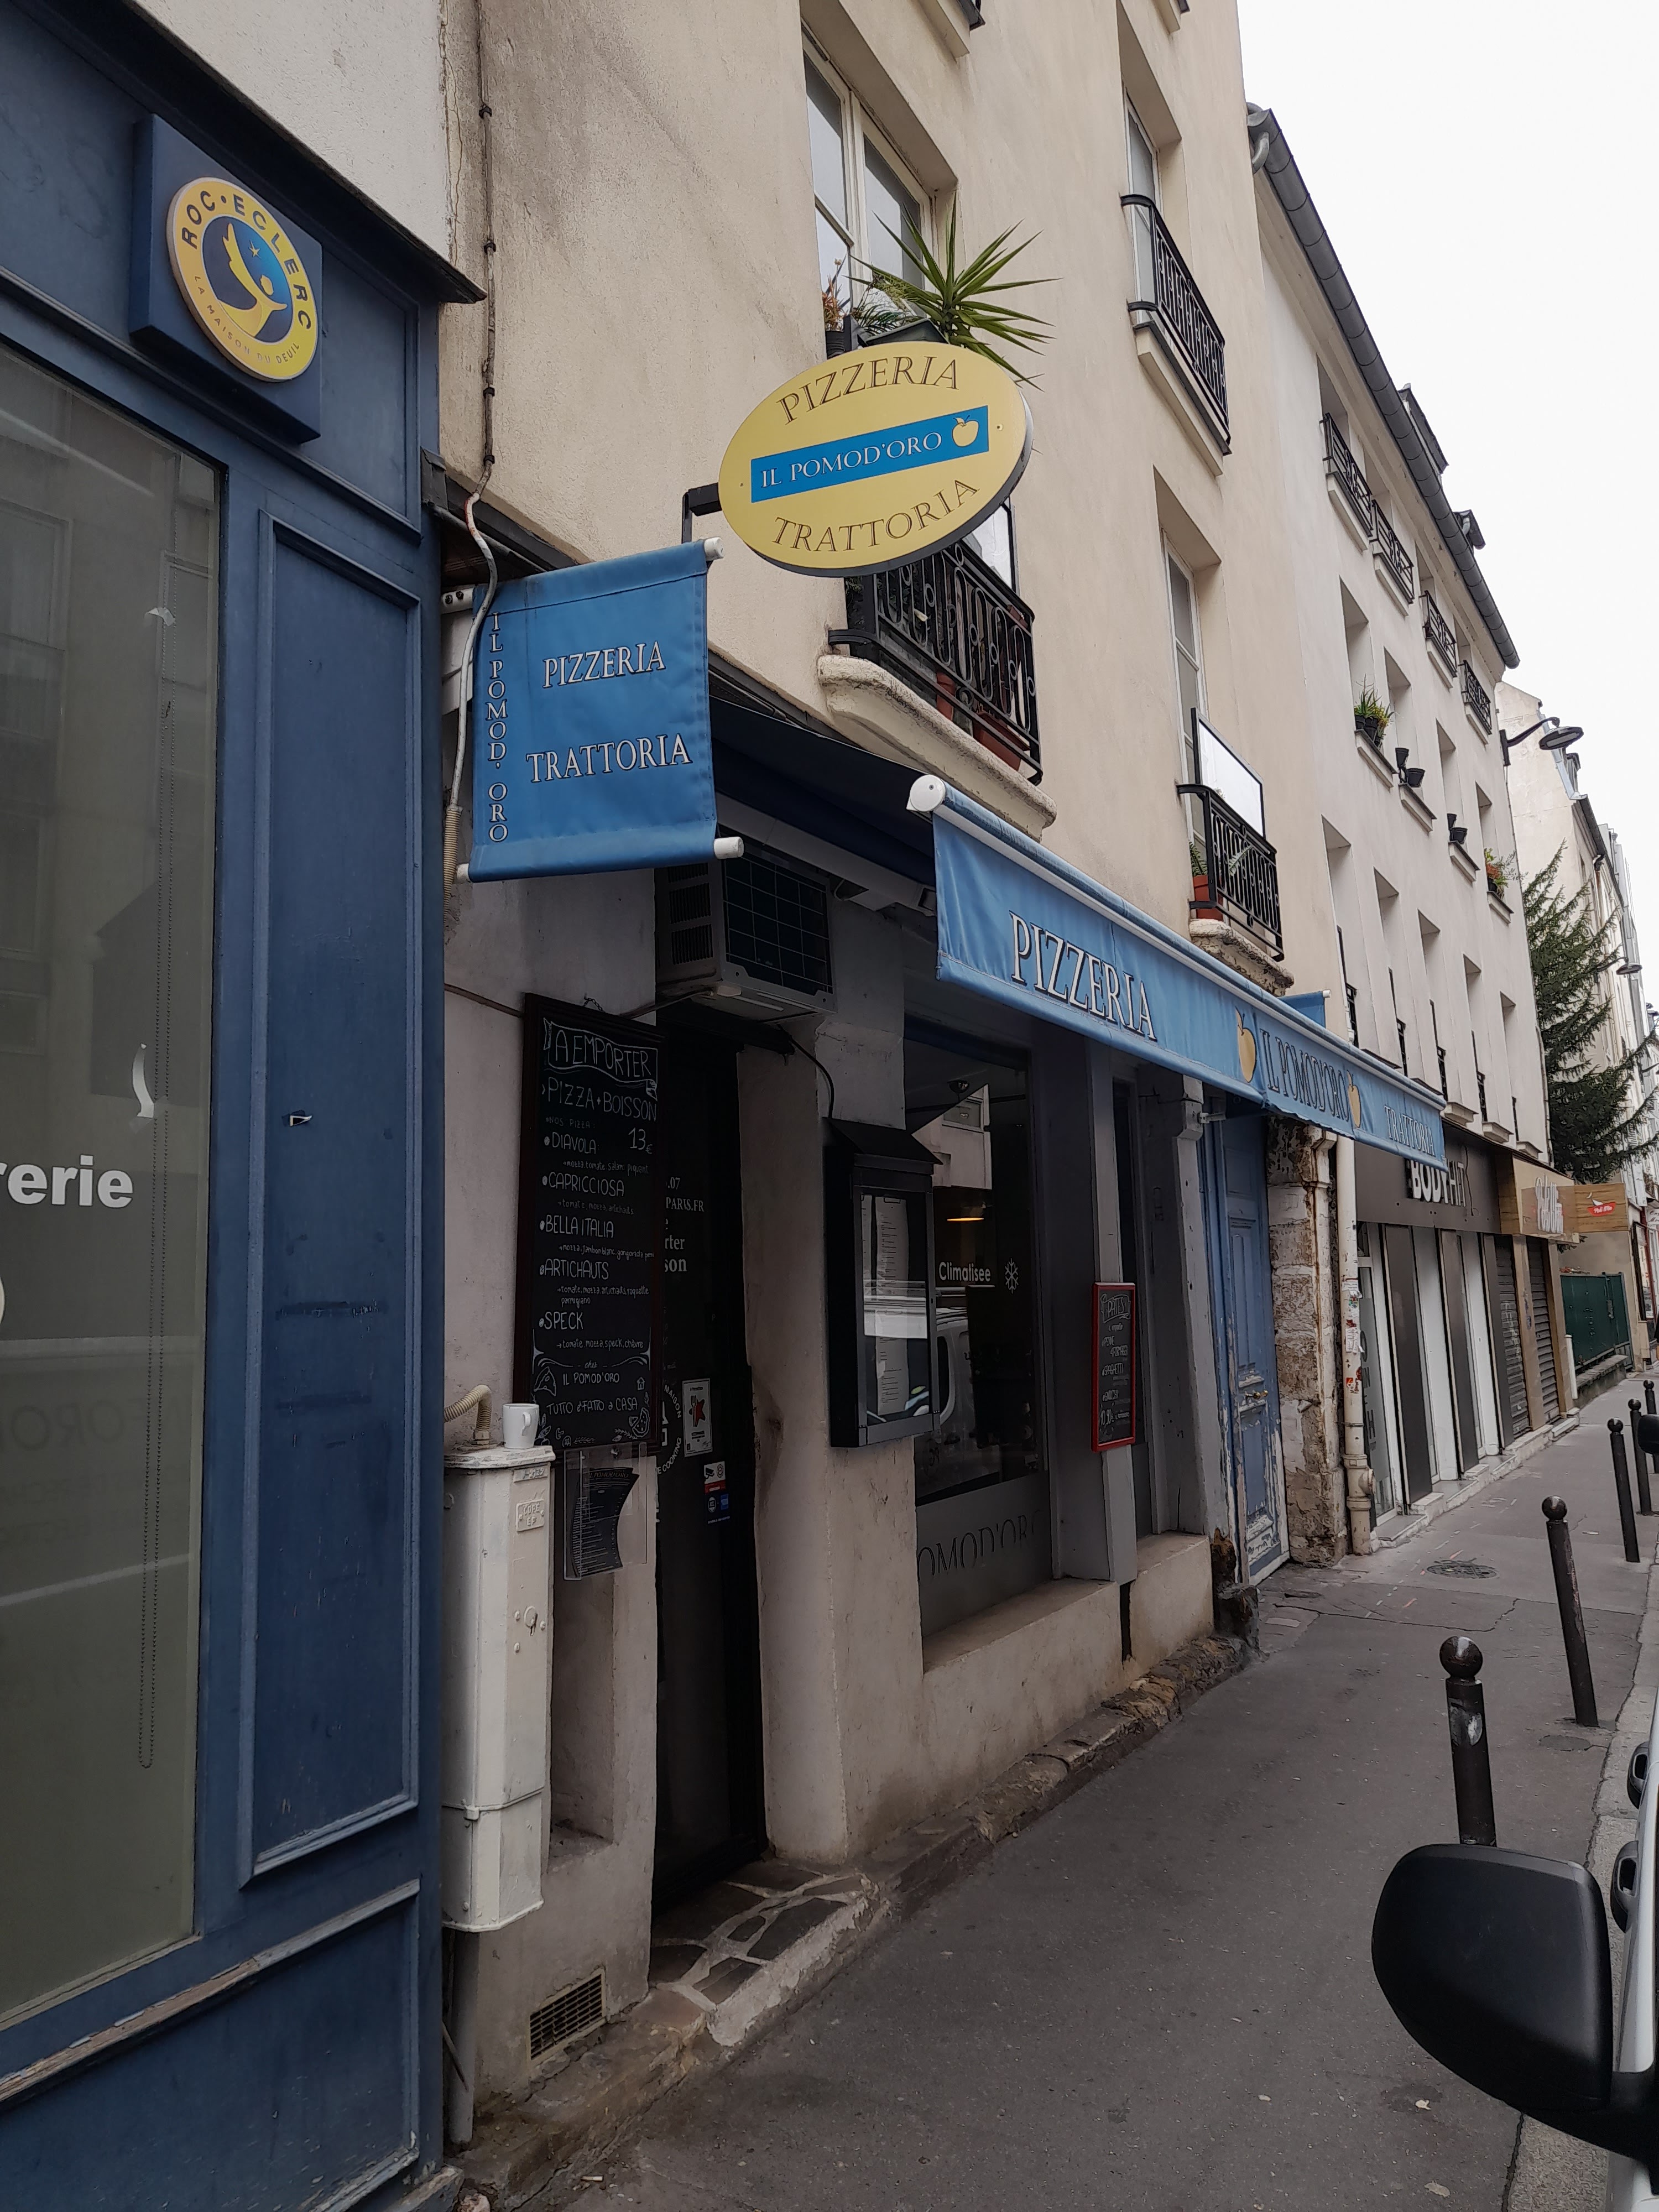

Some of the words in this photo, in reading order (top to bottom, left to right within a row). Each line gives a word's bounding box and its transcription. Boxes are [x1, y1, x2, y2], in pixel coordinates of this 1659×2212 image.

[194, 275, 205, 294] LA
[206, 304, 250, 354] MAISON
[257, 352, 271, 363] DU
[275, 343, 300, 363] DEUIL
[775, 356, 960, 425] PIZZERIA
[760, 467, 782, 488] IL
[790, 431, 942, 481] POMOD'ORO
[771, 479, 980, 553] TRATTORIA
[542, 640, 666, 688] PIZZERIA
[526, 733, 693, 783] TRATTORIA
[1009, 910, 1158, 1042] PIZZERIA
[572, 1035, 651, 1078] EMPORTER
[1260, 1028, 1281, 1094] IL
[547, 1076, 595, 1110] PIZZA
[603, 1091, 658, 1123] BOISSON
[1384, 1104, 1436, 1157] TRATTORIA
[548, 1171, 625, 1197] CAPRICCIOSA
[545, 1214, 579, 1235] BELLA
[581, 1218, 615, 1238] ITALIA
[544, 1258, 609, 1280] ARTICHAUTS
[544, 1311, 584, 1331] SPECK
[562, 1373, 570, 1386] IL
[664, 1384, 682, 1418] MAISON
[546, 1402, 573, 1416] TUTTO
[615, 1397, 638, 1411] CASA
[662, 1437, 682, 1473] COOKING
